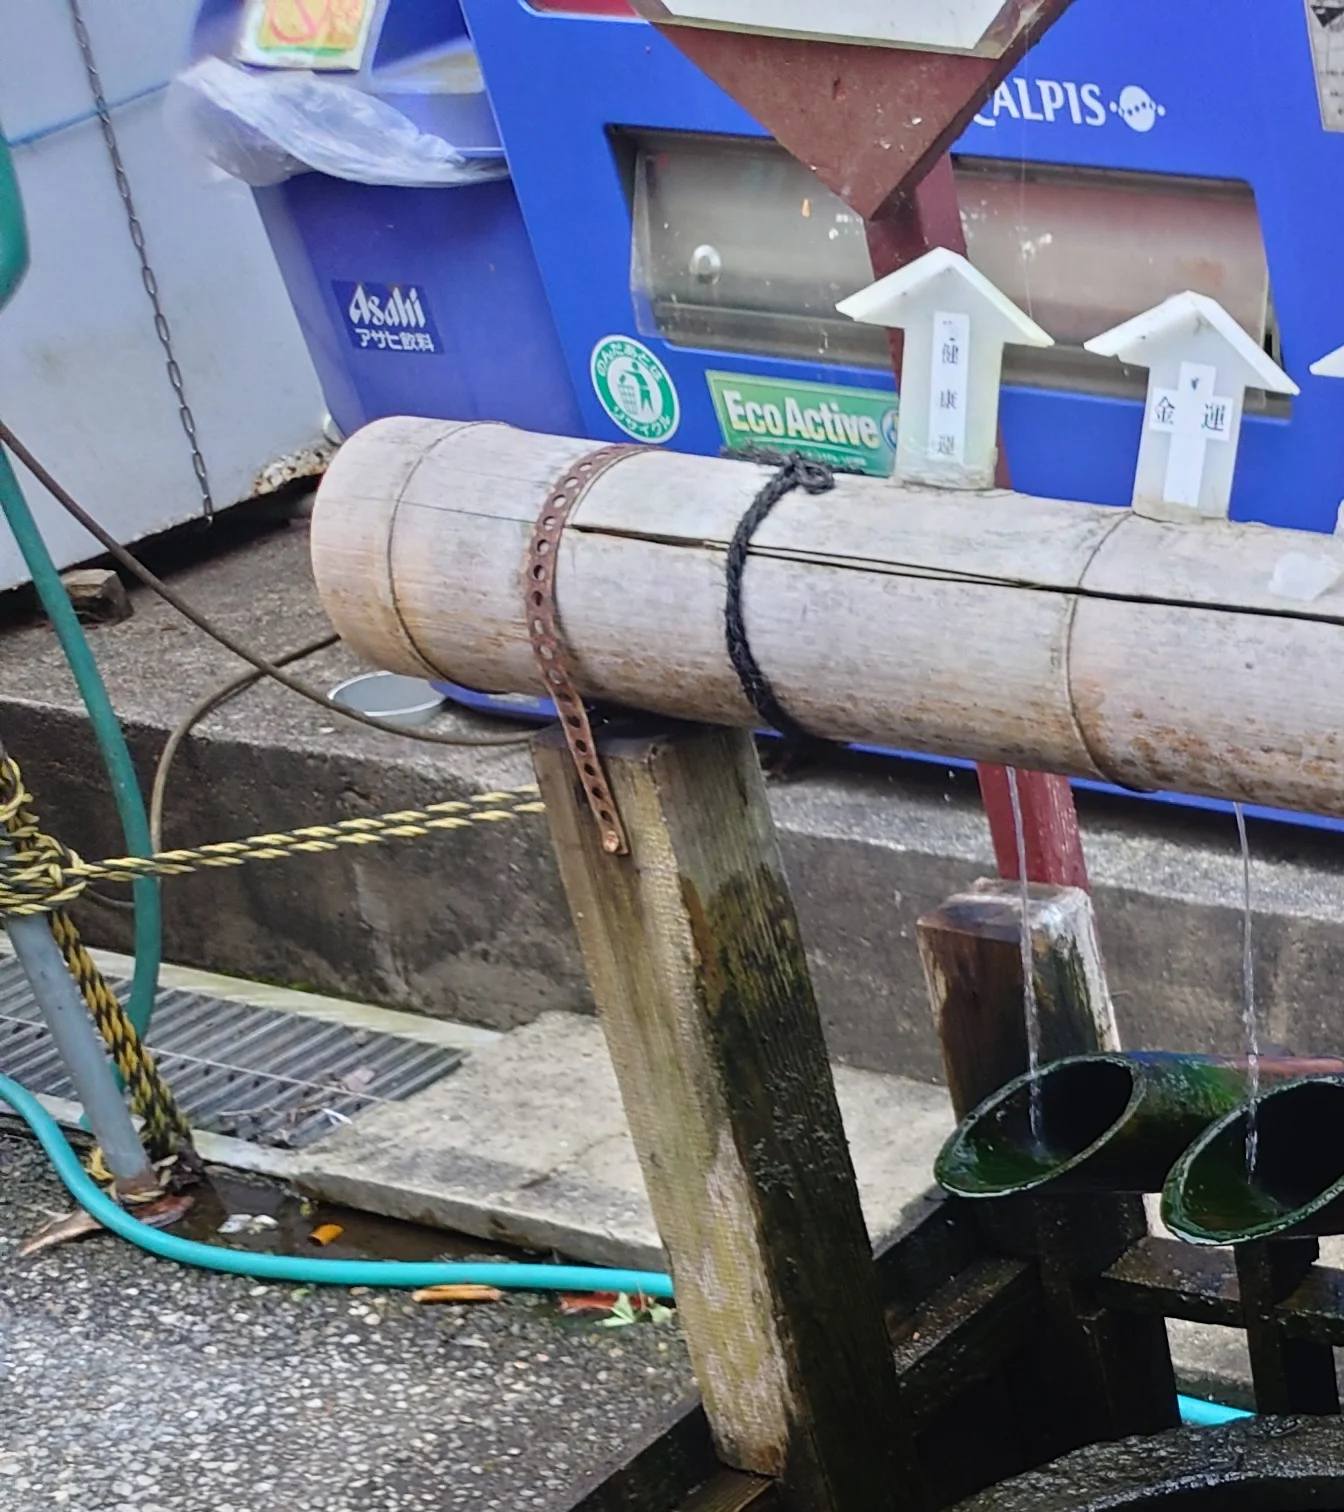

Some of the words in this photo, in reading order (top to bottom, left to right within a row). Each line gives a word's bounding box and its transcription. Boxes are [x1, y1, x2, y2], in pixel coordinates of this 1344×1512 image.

[349, 284, 426, 329] Asahi
[355, 327, 434, 353] アサヒ飲料
